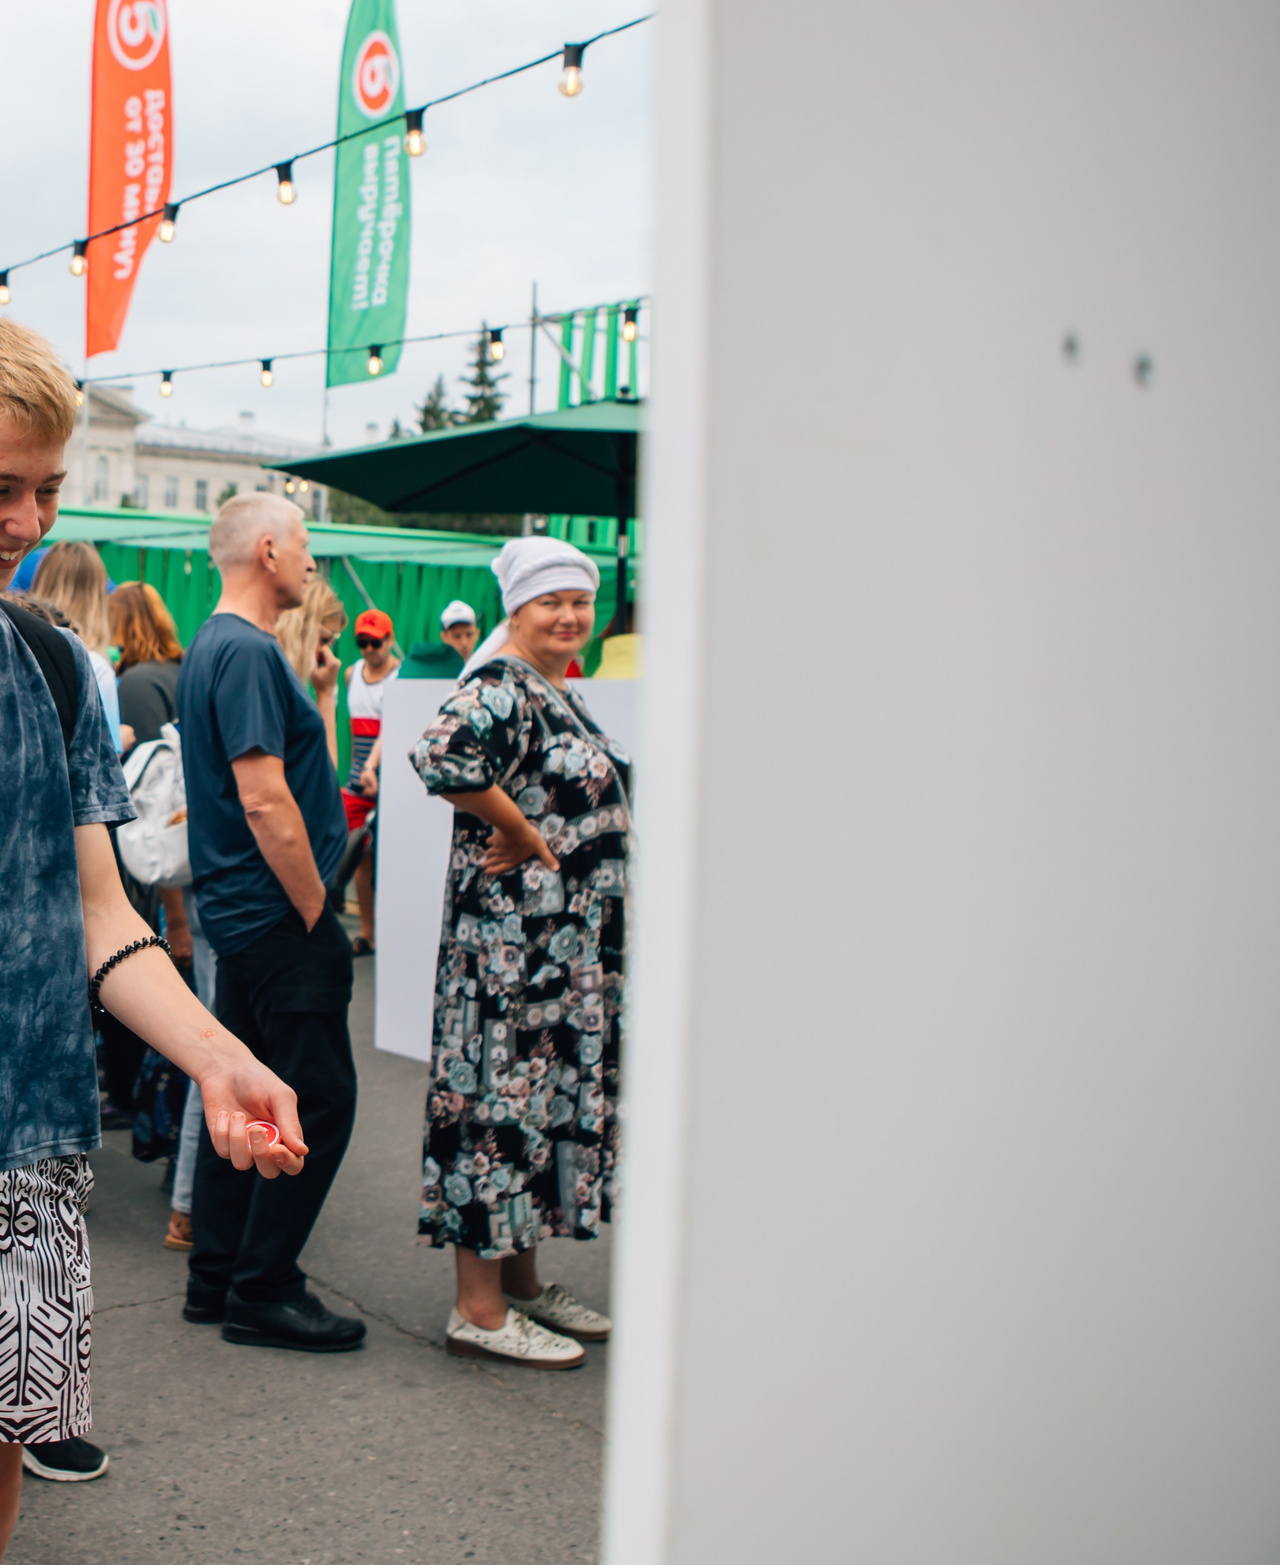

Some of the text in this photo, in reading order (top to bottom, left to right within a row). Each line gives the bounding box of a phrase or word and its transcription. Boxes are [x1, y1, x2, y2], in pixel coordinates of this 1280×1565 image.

[124, 96, 143, 133] от
[124, 138, 145, 178] 30
[352, 143, 379, 311] выручает!
[372, 135, 402, 307] Пятёрочка
